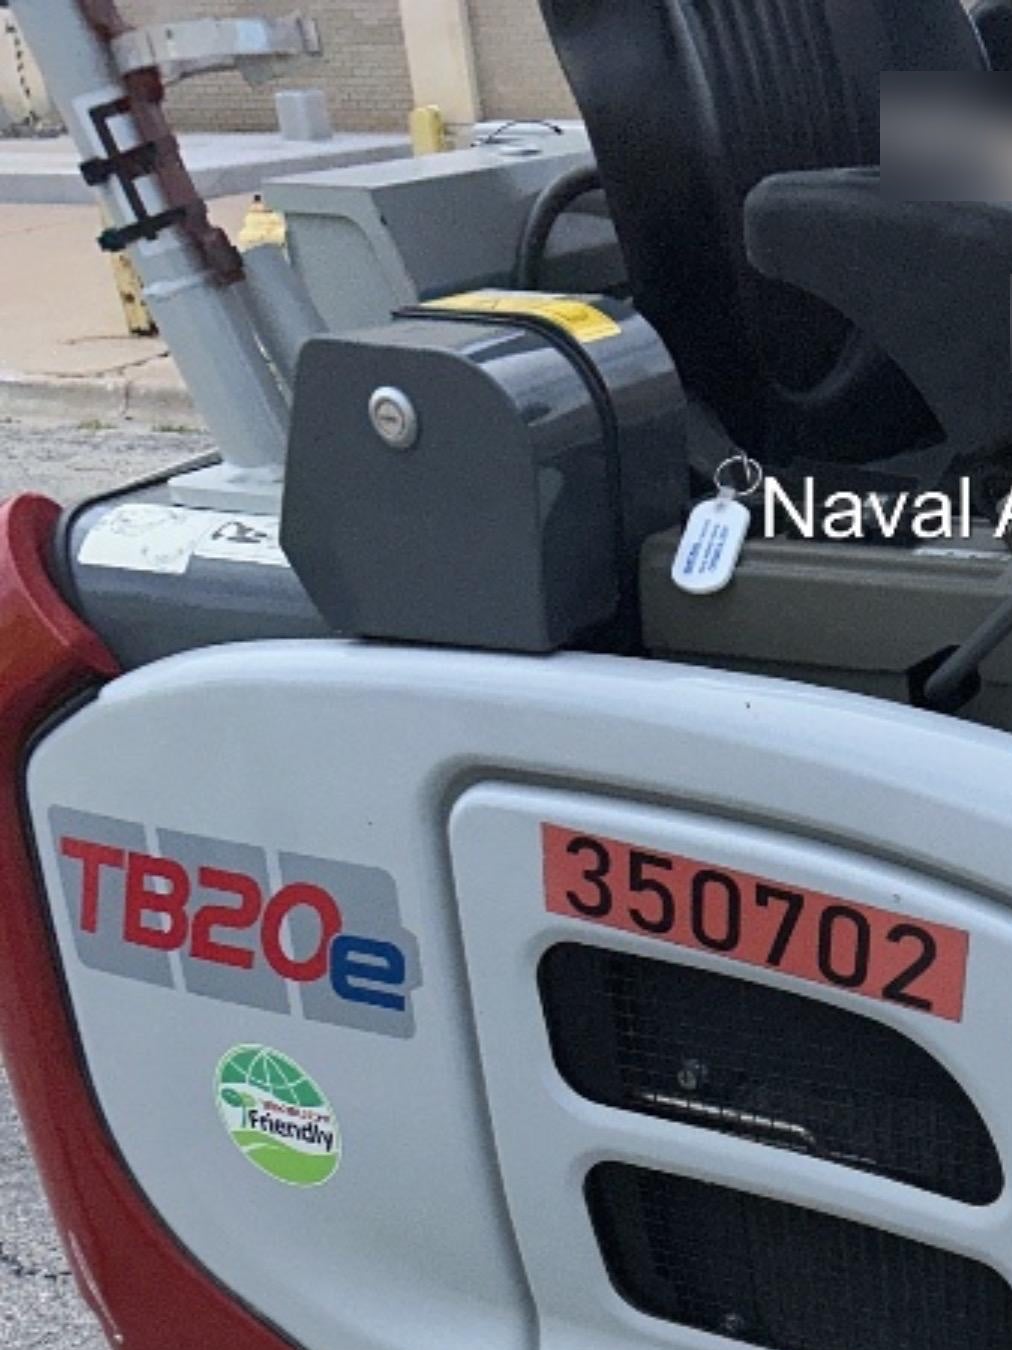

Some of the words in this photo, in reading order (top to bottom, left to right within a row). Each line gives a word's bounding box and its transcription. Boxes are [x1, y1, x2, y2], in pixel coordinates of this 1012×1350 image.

[60, 836, 406, 1012] TB20e
[565, 835, 938, 1012] 350702
[248, 1109, 334, 1153] Friendly
